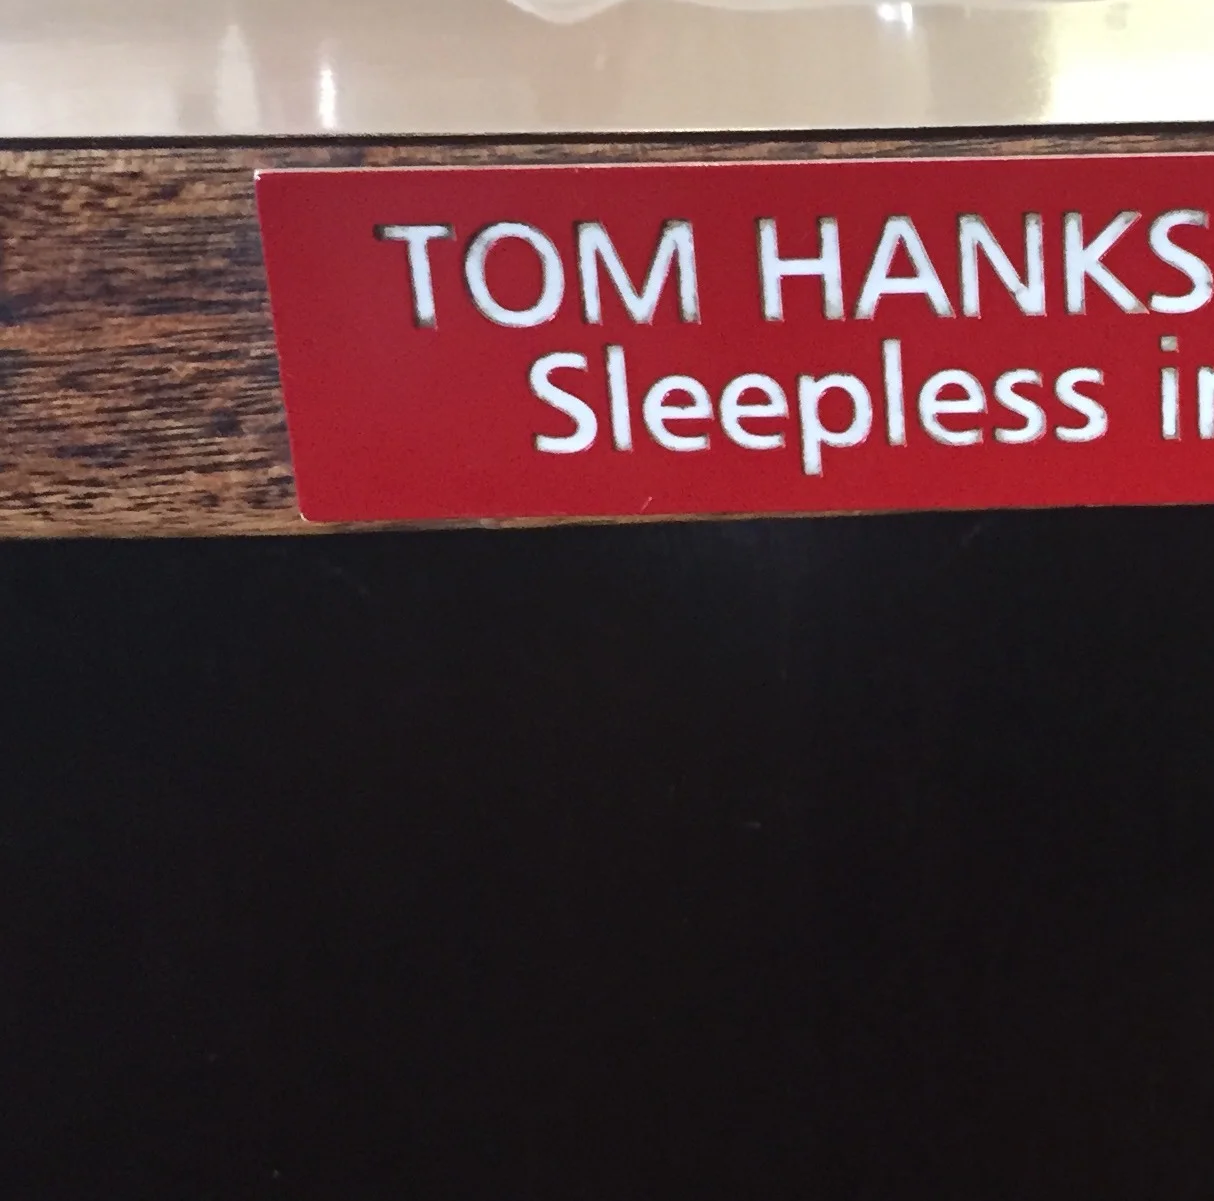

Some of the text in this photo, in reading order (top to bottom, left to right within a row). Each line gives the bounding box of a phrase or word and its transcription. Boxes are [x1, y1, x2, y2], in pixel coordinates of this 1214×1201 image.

[377, 220, 701, 328] TOM
[758, 209, 1214, 321] HANKS
[529, 339, 1108, 477] Sleepless
